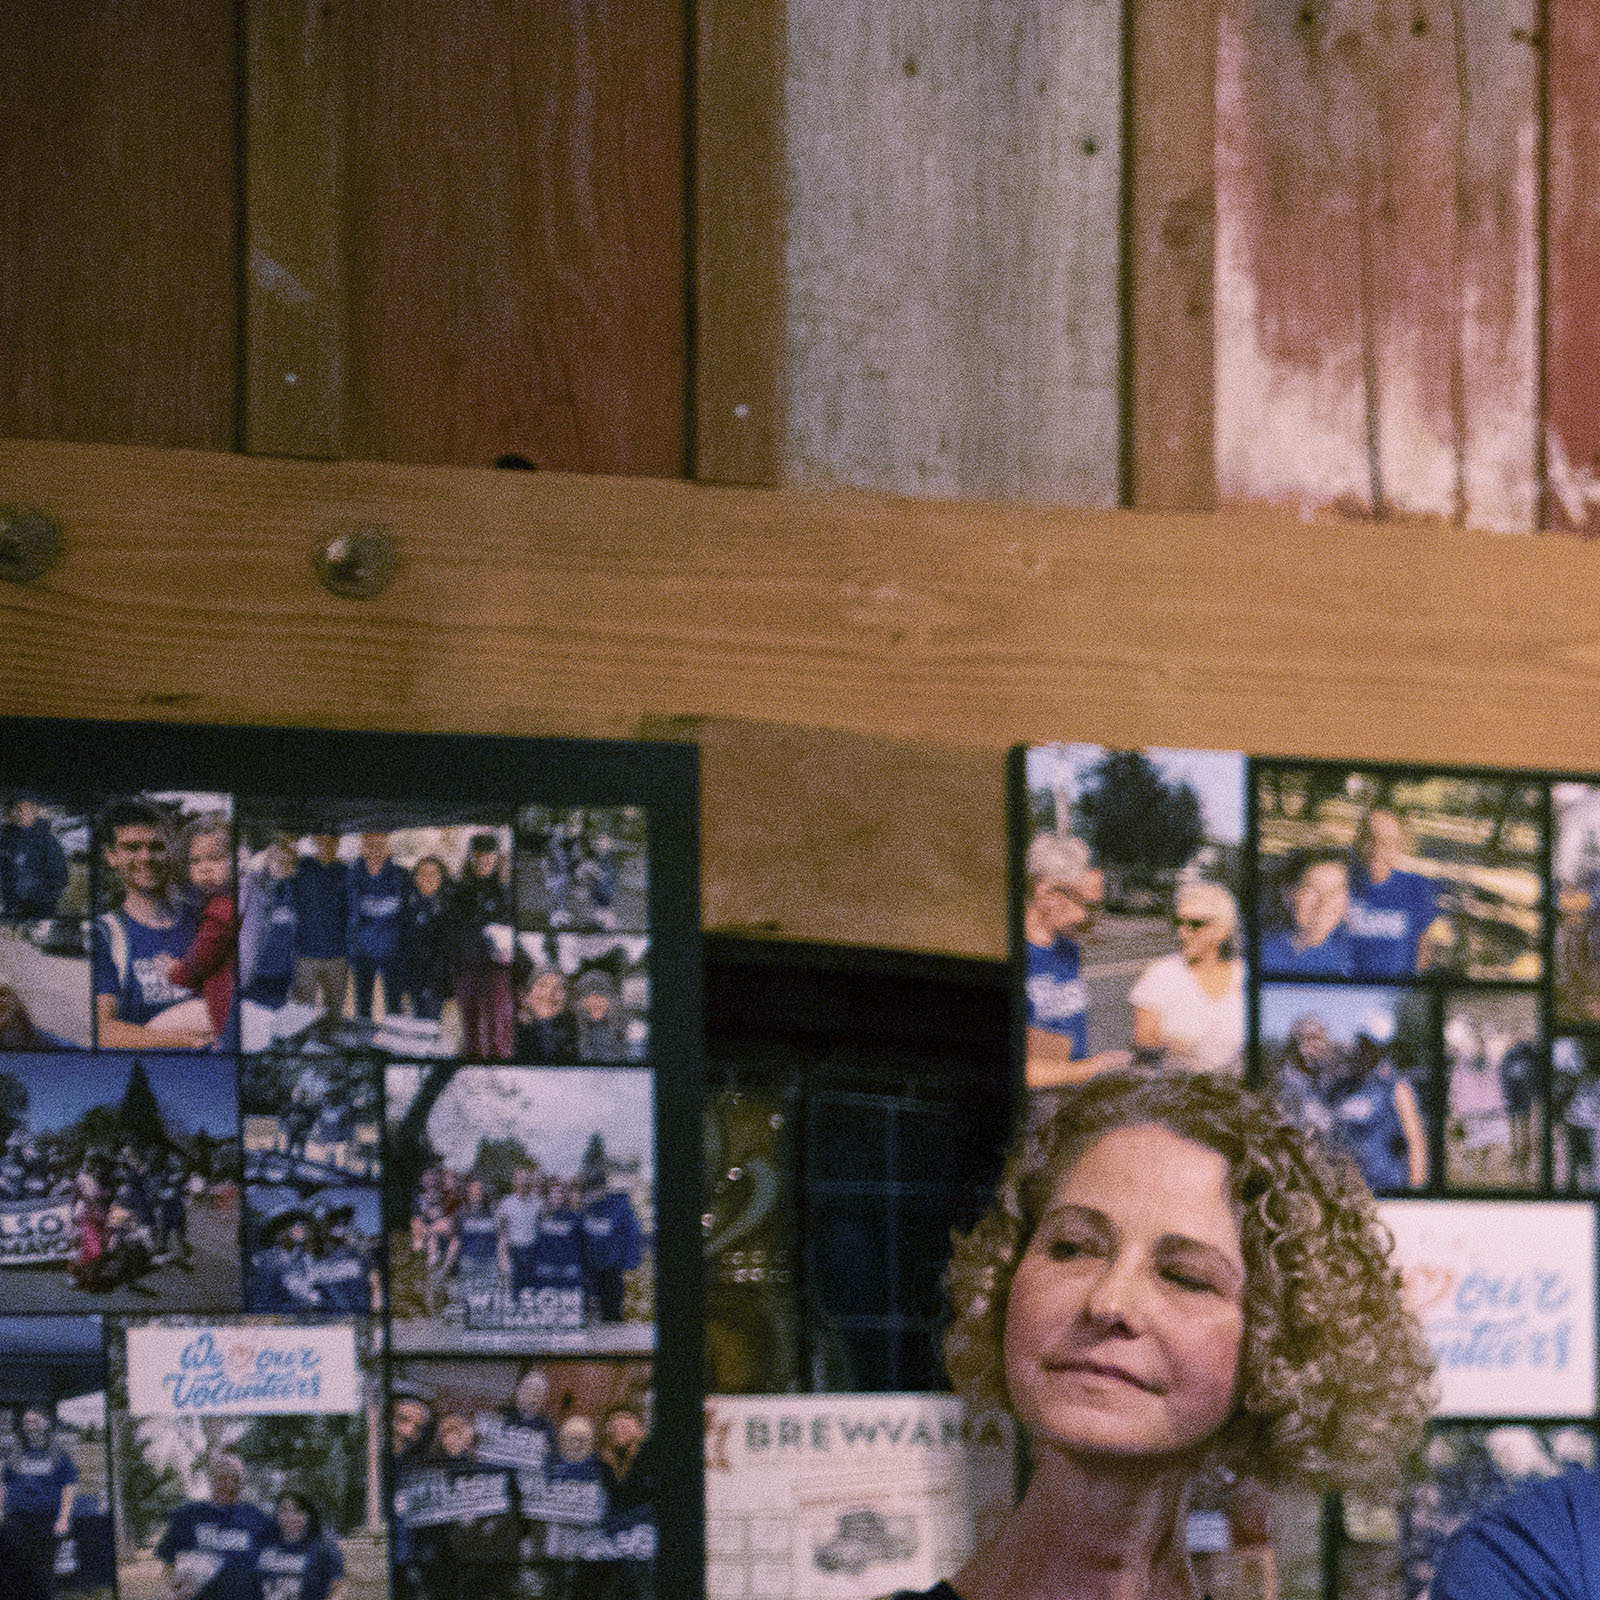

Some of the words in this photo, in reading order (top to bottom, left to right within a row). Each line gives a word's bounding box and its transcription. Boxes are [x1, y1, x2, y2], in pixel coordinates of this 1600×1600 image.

[465, 1286, 583, 1313] WILSON
[179, 1332, 224, 1371] We
[162, 1370, 323, 1410] Volunteers
